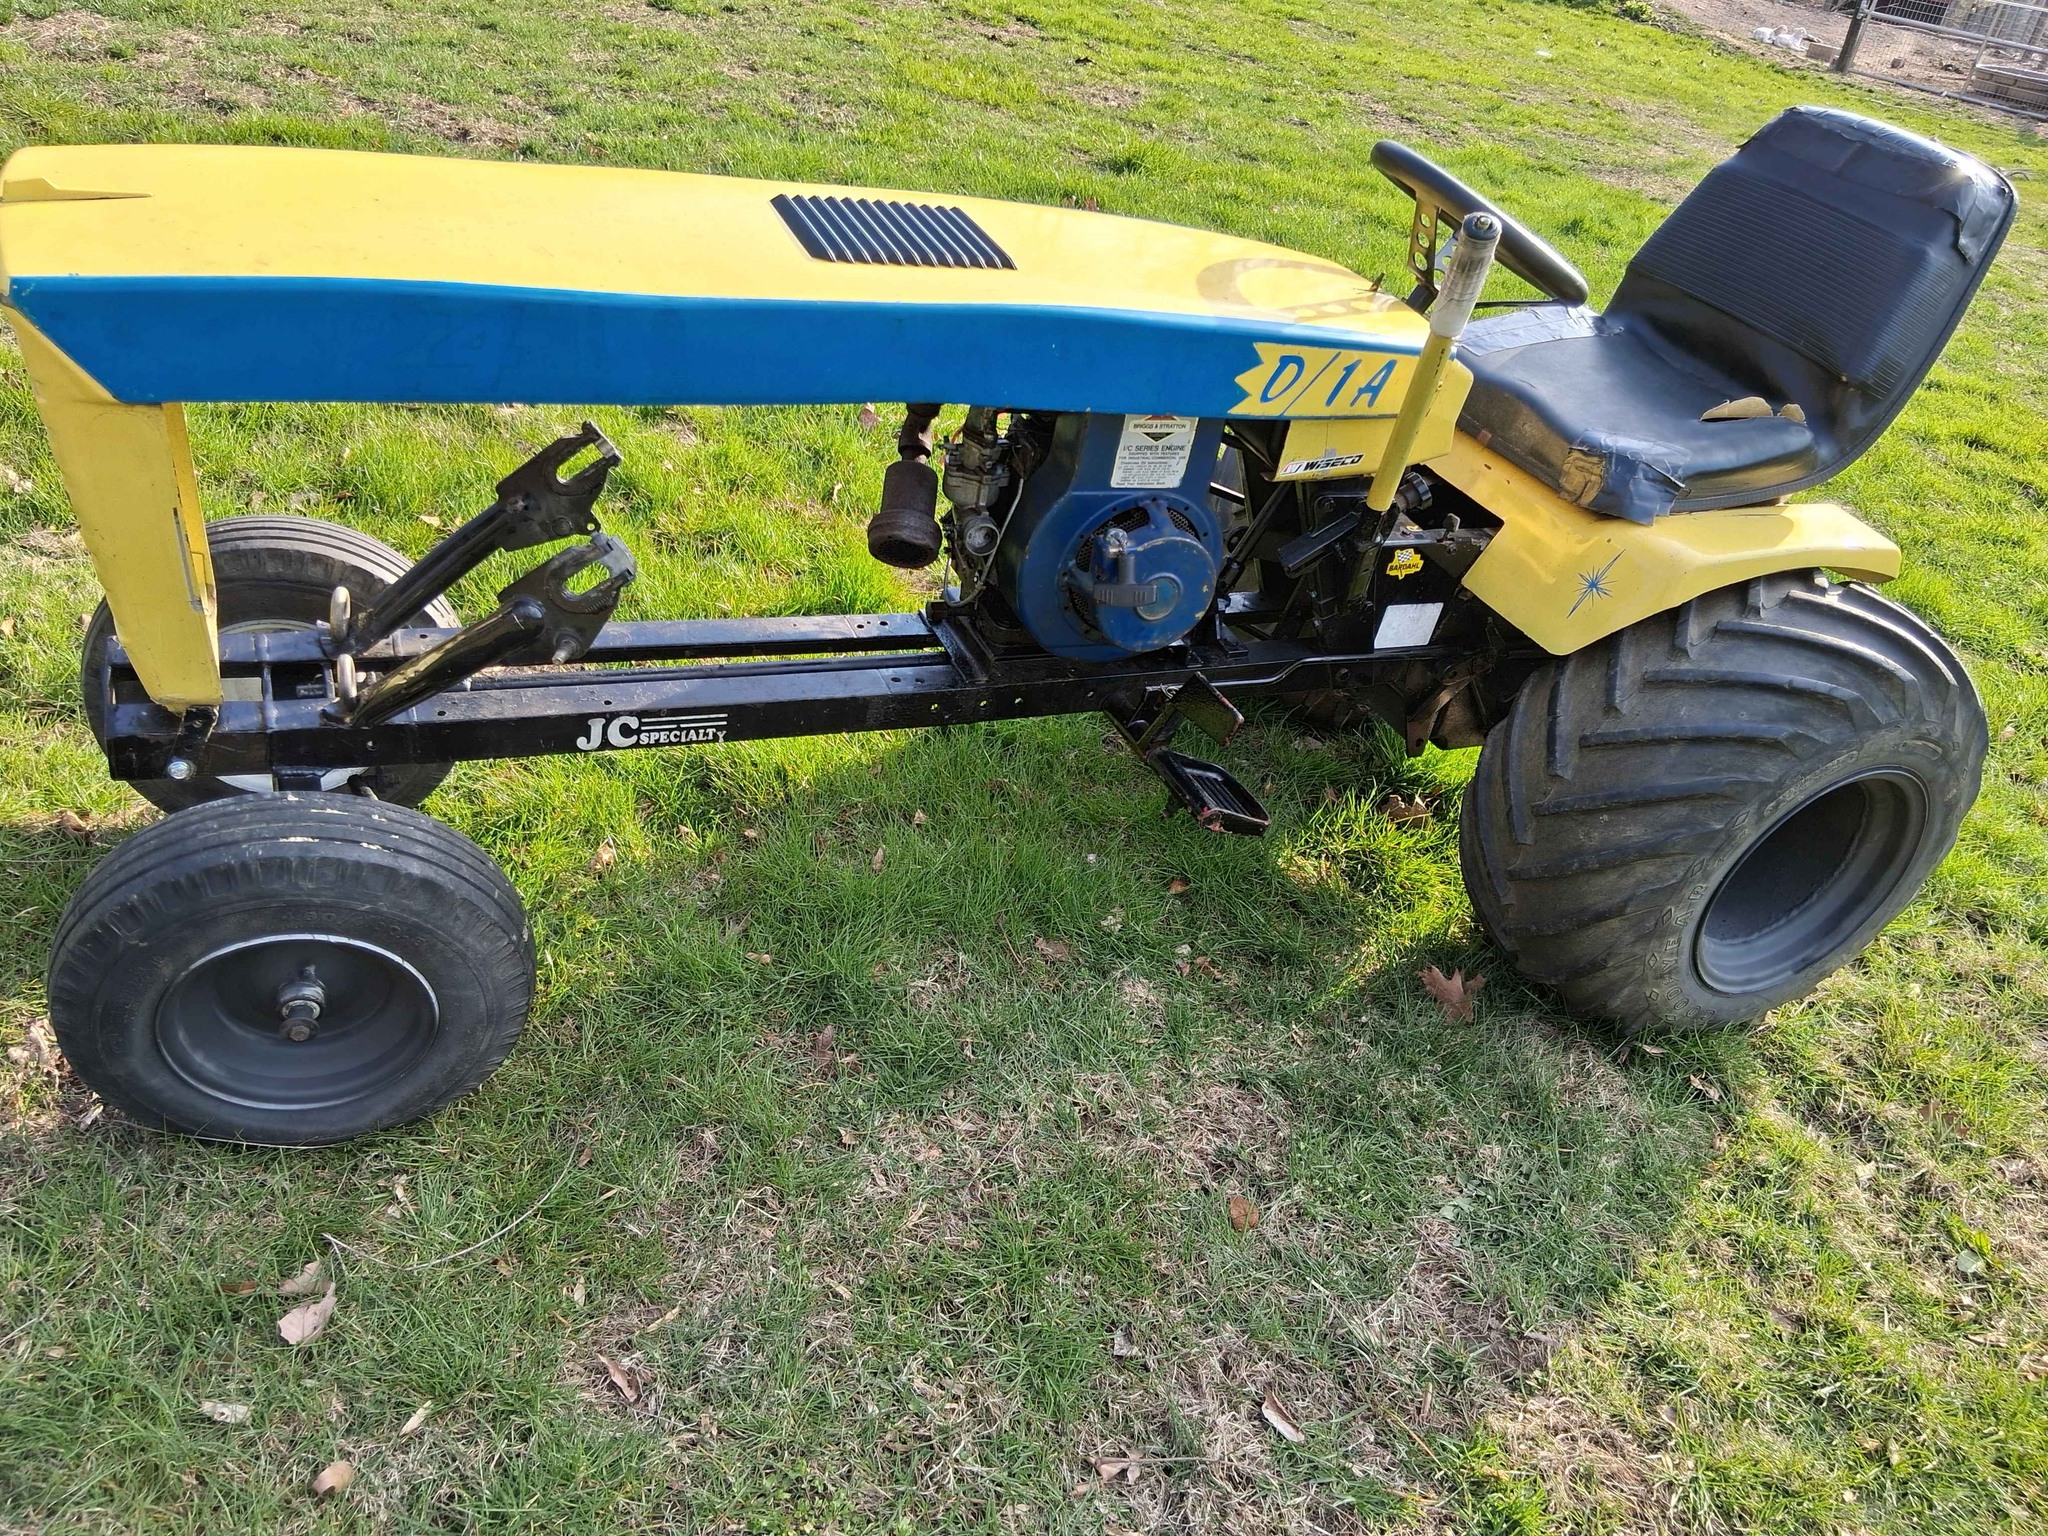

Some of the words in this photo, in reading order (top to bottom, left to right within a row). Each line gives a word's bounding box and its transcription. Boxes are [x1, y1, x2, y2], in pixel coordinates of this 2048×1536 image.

[1389, 563, 1420, 571] BARDAHL
[576, 716, 640, 750] JC
[639, 728, 728, 746] SPECIALTY
